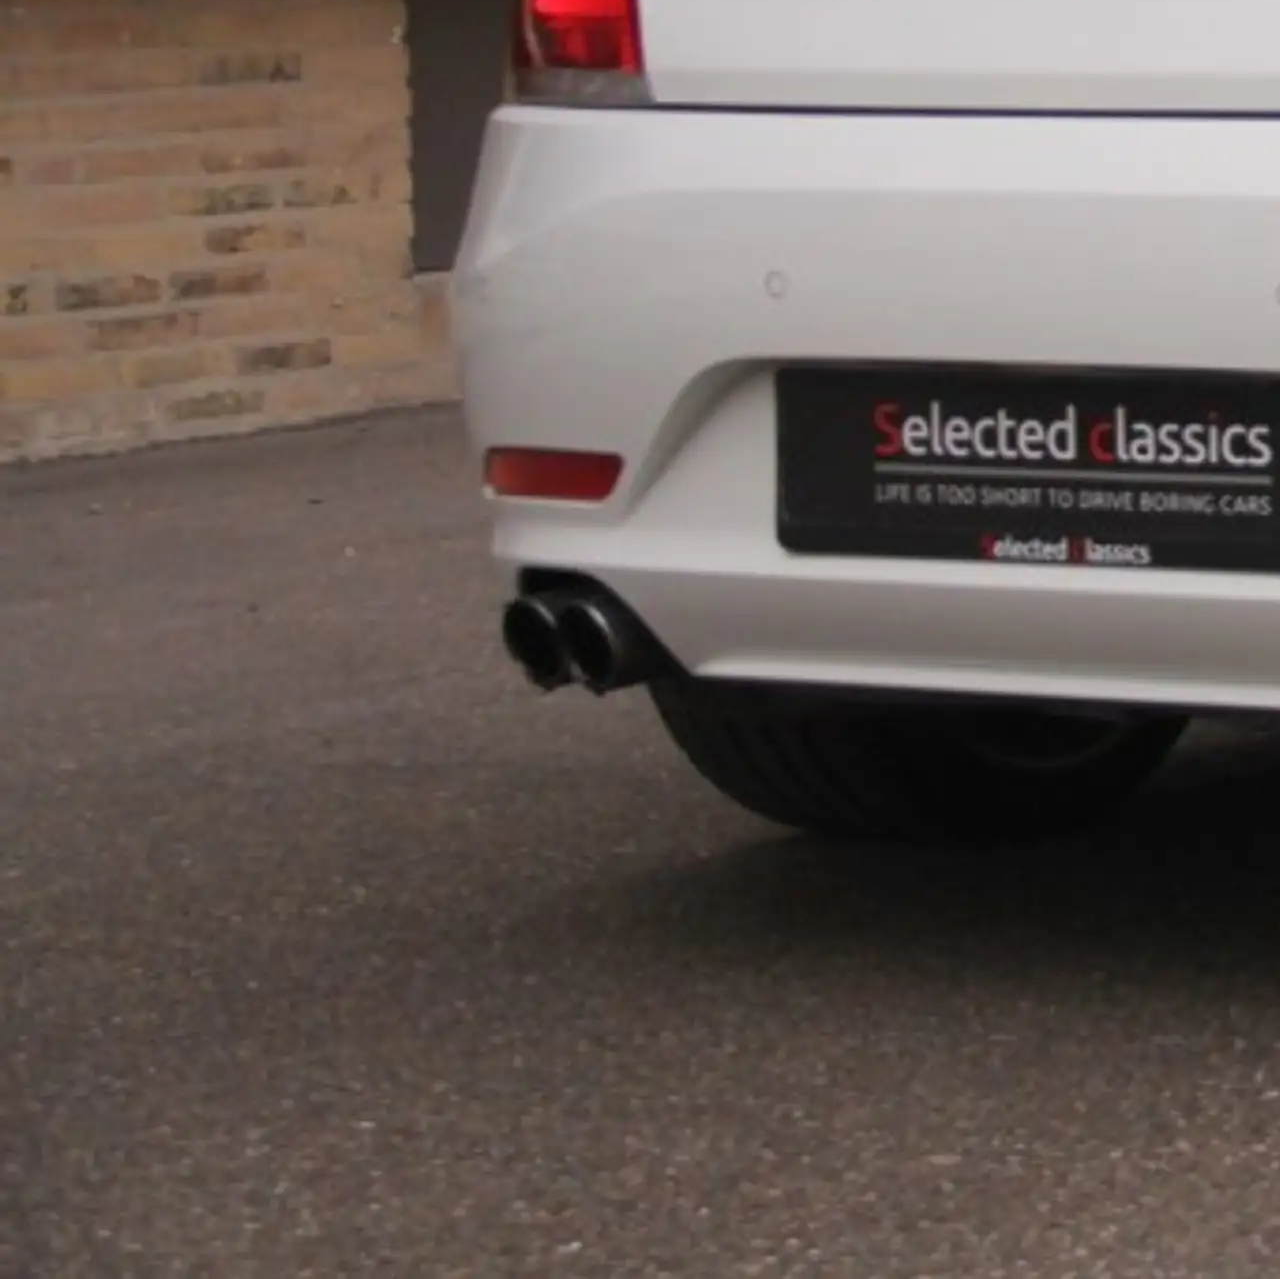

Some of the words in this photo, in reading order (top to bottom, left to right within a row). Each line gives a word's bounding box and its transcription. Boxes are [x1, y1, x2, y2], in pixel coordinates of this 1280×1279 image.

[874, 400, 1077, 460] Selected
[875, 483, 911, 504] LIFE
[914, 484, 932, 505] IS
[937, 483, 976, 507] TOO
[980, 485, 1042, 508] SHORT
[1047, 486, 1074, 509] TO
[1079, 489, 1135, 512] DRIVE
[1140, 491, 1215, 515] BORING
[1219, 493, 1273, 516] CARS
